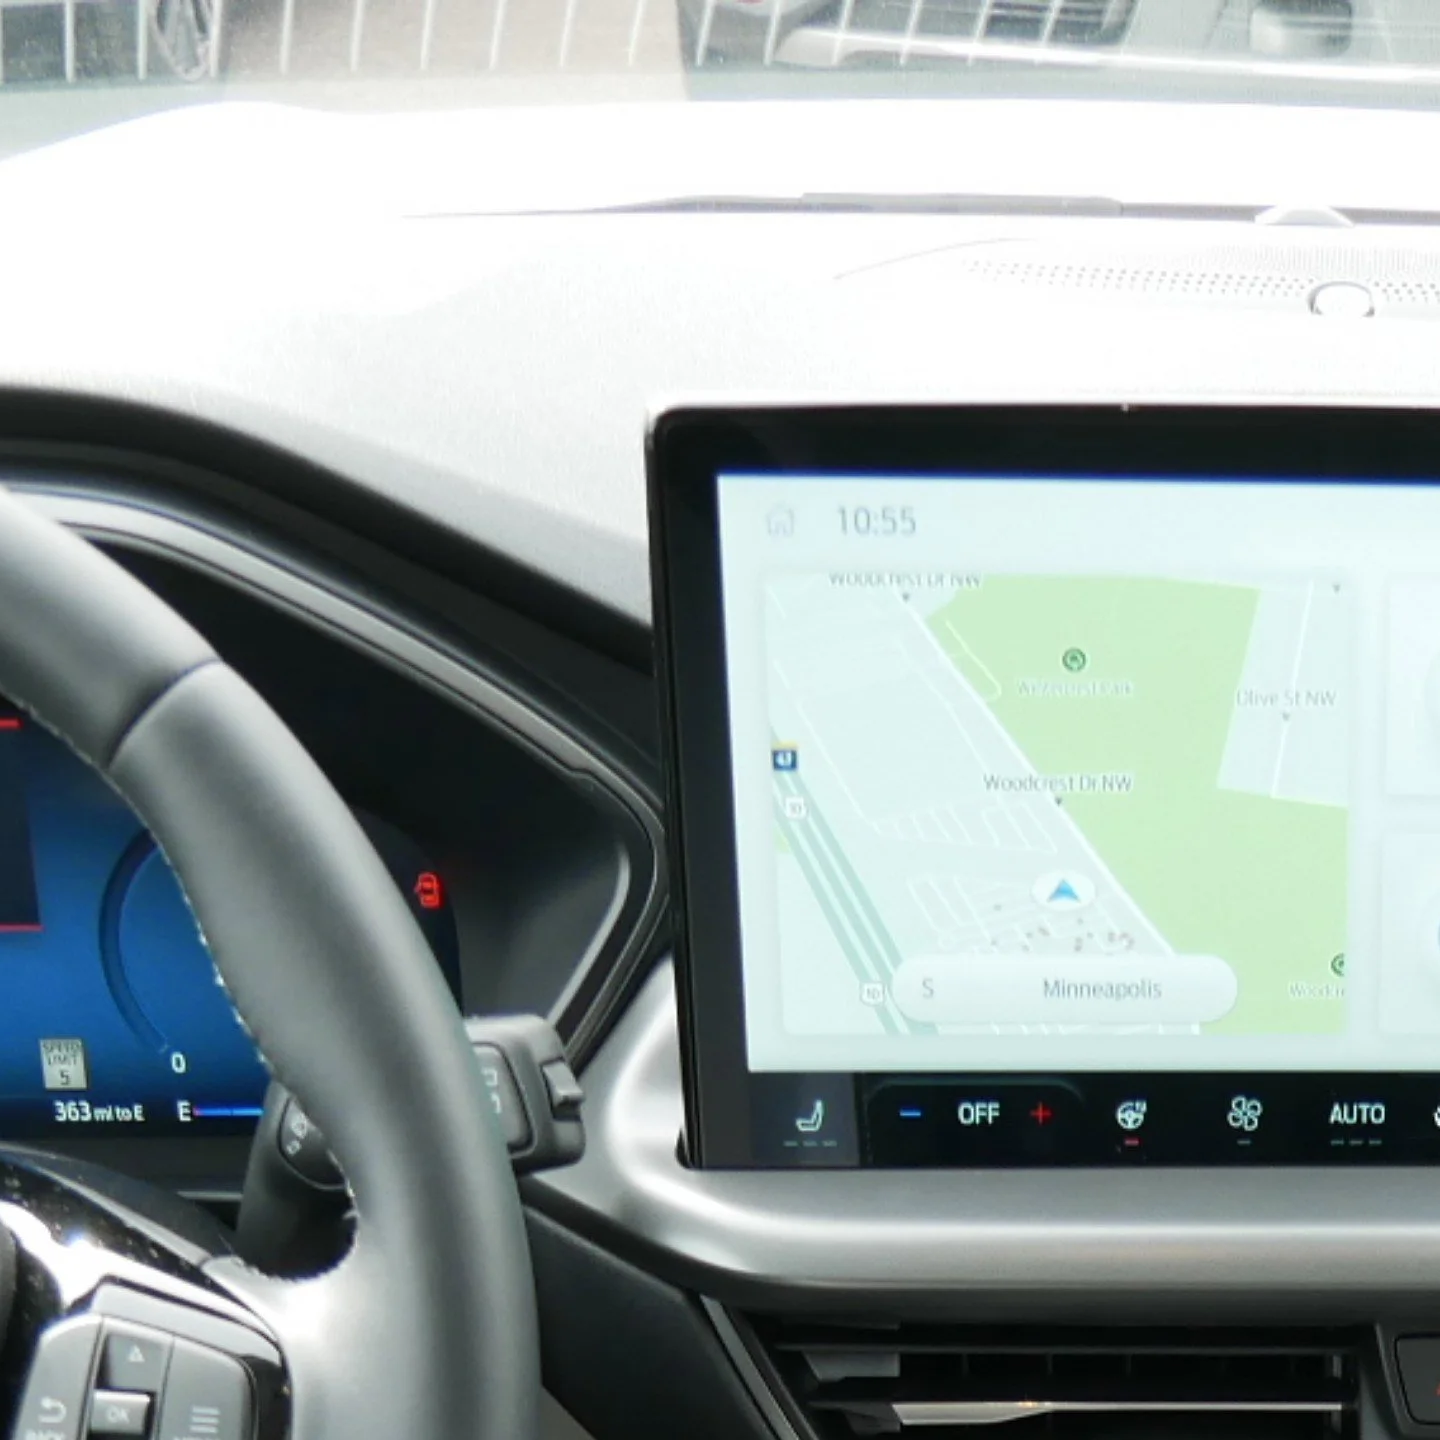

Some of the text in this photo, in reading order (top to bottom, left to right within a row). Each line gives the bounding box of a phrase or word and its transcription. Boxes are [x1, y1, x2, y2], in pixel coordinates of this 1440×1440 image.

[836, 504, 917, 537] 10:55
[1305, 690, 1337, 707] NW
[982, 773, 1133, 793] Woodcrest Dr NW
[921, 978, 1164, 1003] S Minneapolis
[170, 1052, 187, 1074] 0
[54, 1100, 92, 1122] 363
[177, 1100, 192, 1122] E
[957, 1101, 1000, 1126] OFF
[1329, 1101, 1386, 1126] AUTO
[105, 1406, 130, 1425] OK
